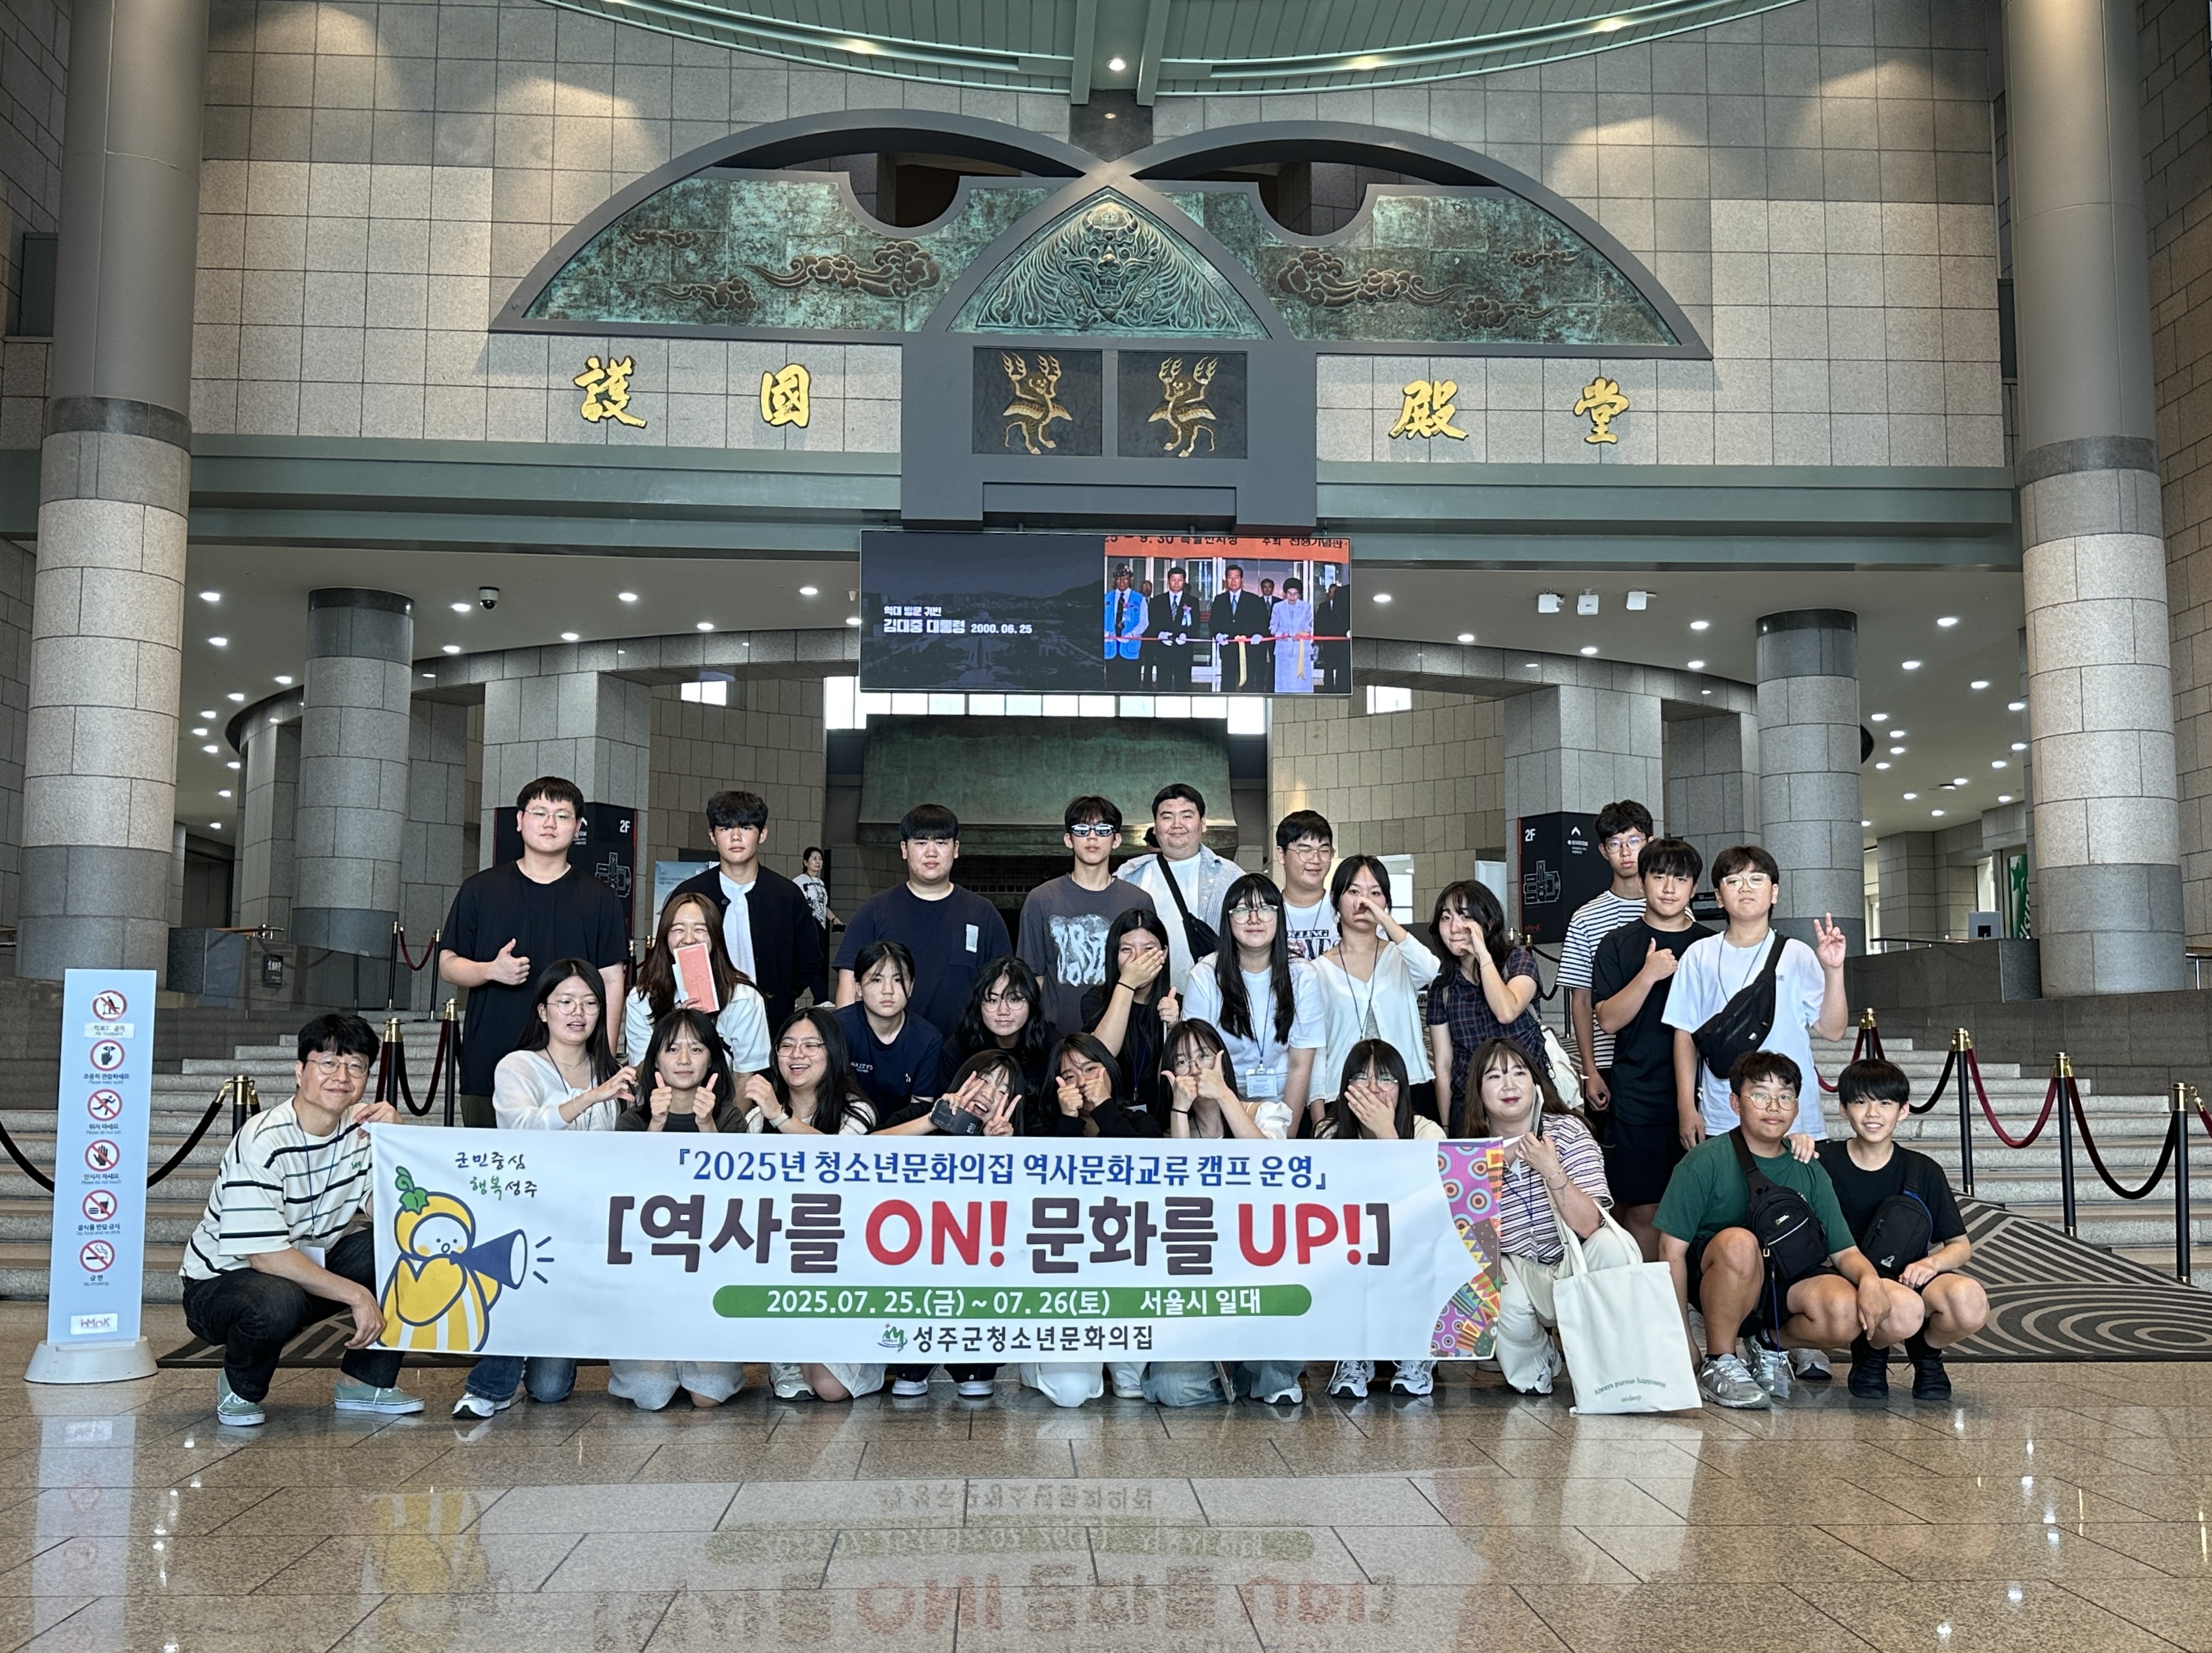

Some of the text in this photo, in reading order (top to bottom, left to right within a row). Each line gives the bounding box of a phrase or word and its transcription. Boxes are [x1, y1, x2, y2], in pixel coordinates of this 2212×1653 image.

[884, 606, 902, 616] 역대
[924, 606, 942, 616] 귀빈
[883, 619, 923, 633] 김대중
[926, 619, 966, 634] 대통령
[620, 820, 630, 833] 2F
[1525, 828, 1536, 842] 2F
[814, 1151, 1013, 1184] 청소년문화의집
[1023, 1154, 1190, 1186] 역사문화교류
[1197, 1155, 1251, 1187] 캠프
[607, 1193, 1390, 1276] [역사를 ON! 문화를 UP!]
[1140, 1289, 1207, 1316] 서울시
[1215, 1288, 1260, 1314] 일대
[913, 1324, 1153, 1354] 성주군청소년문화의집
[1594, 1376, 1666, 1396] Always pursue happiness
